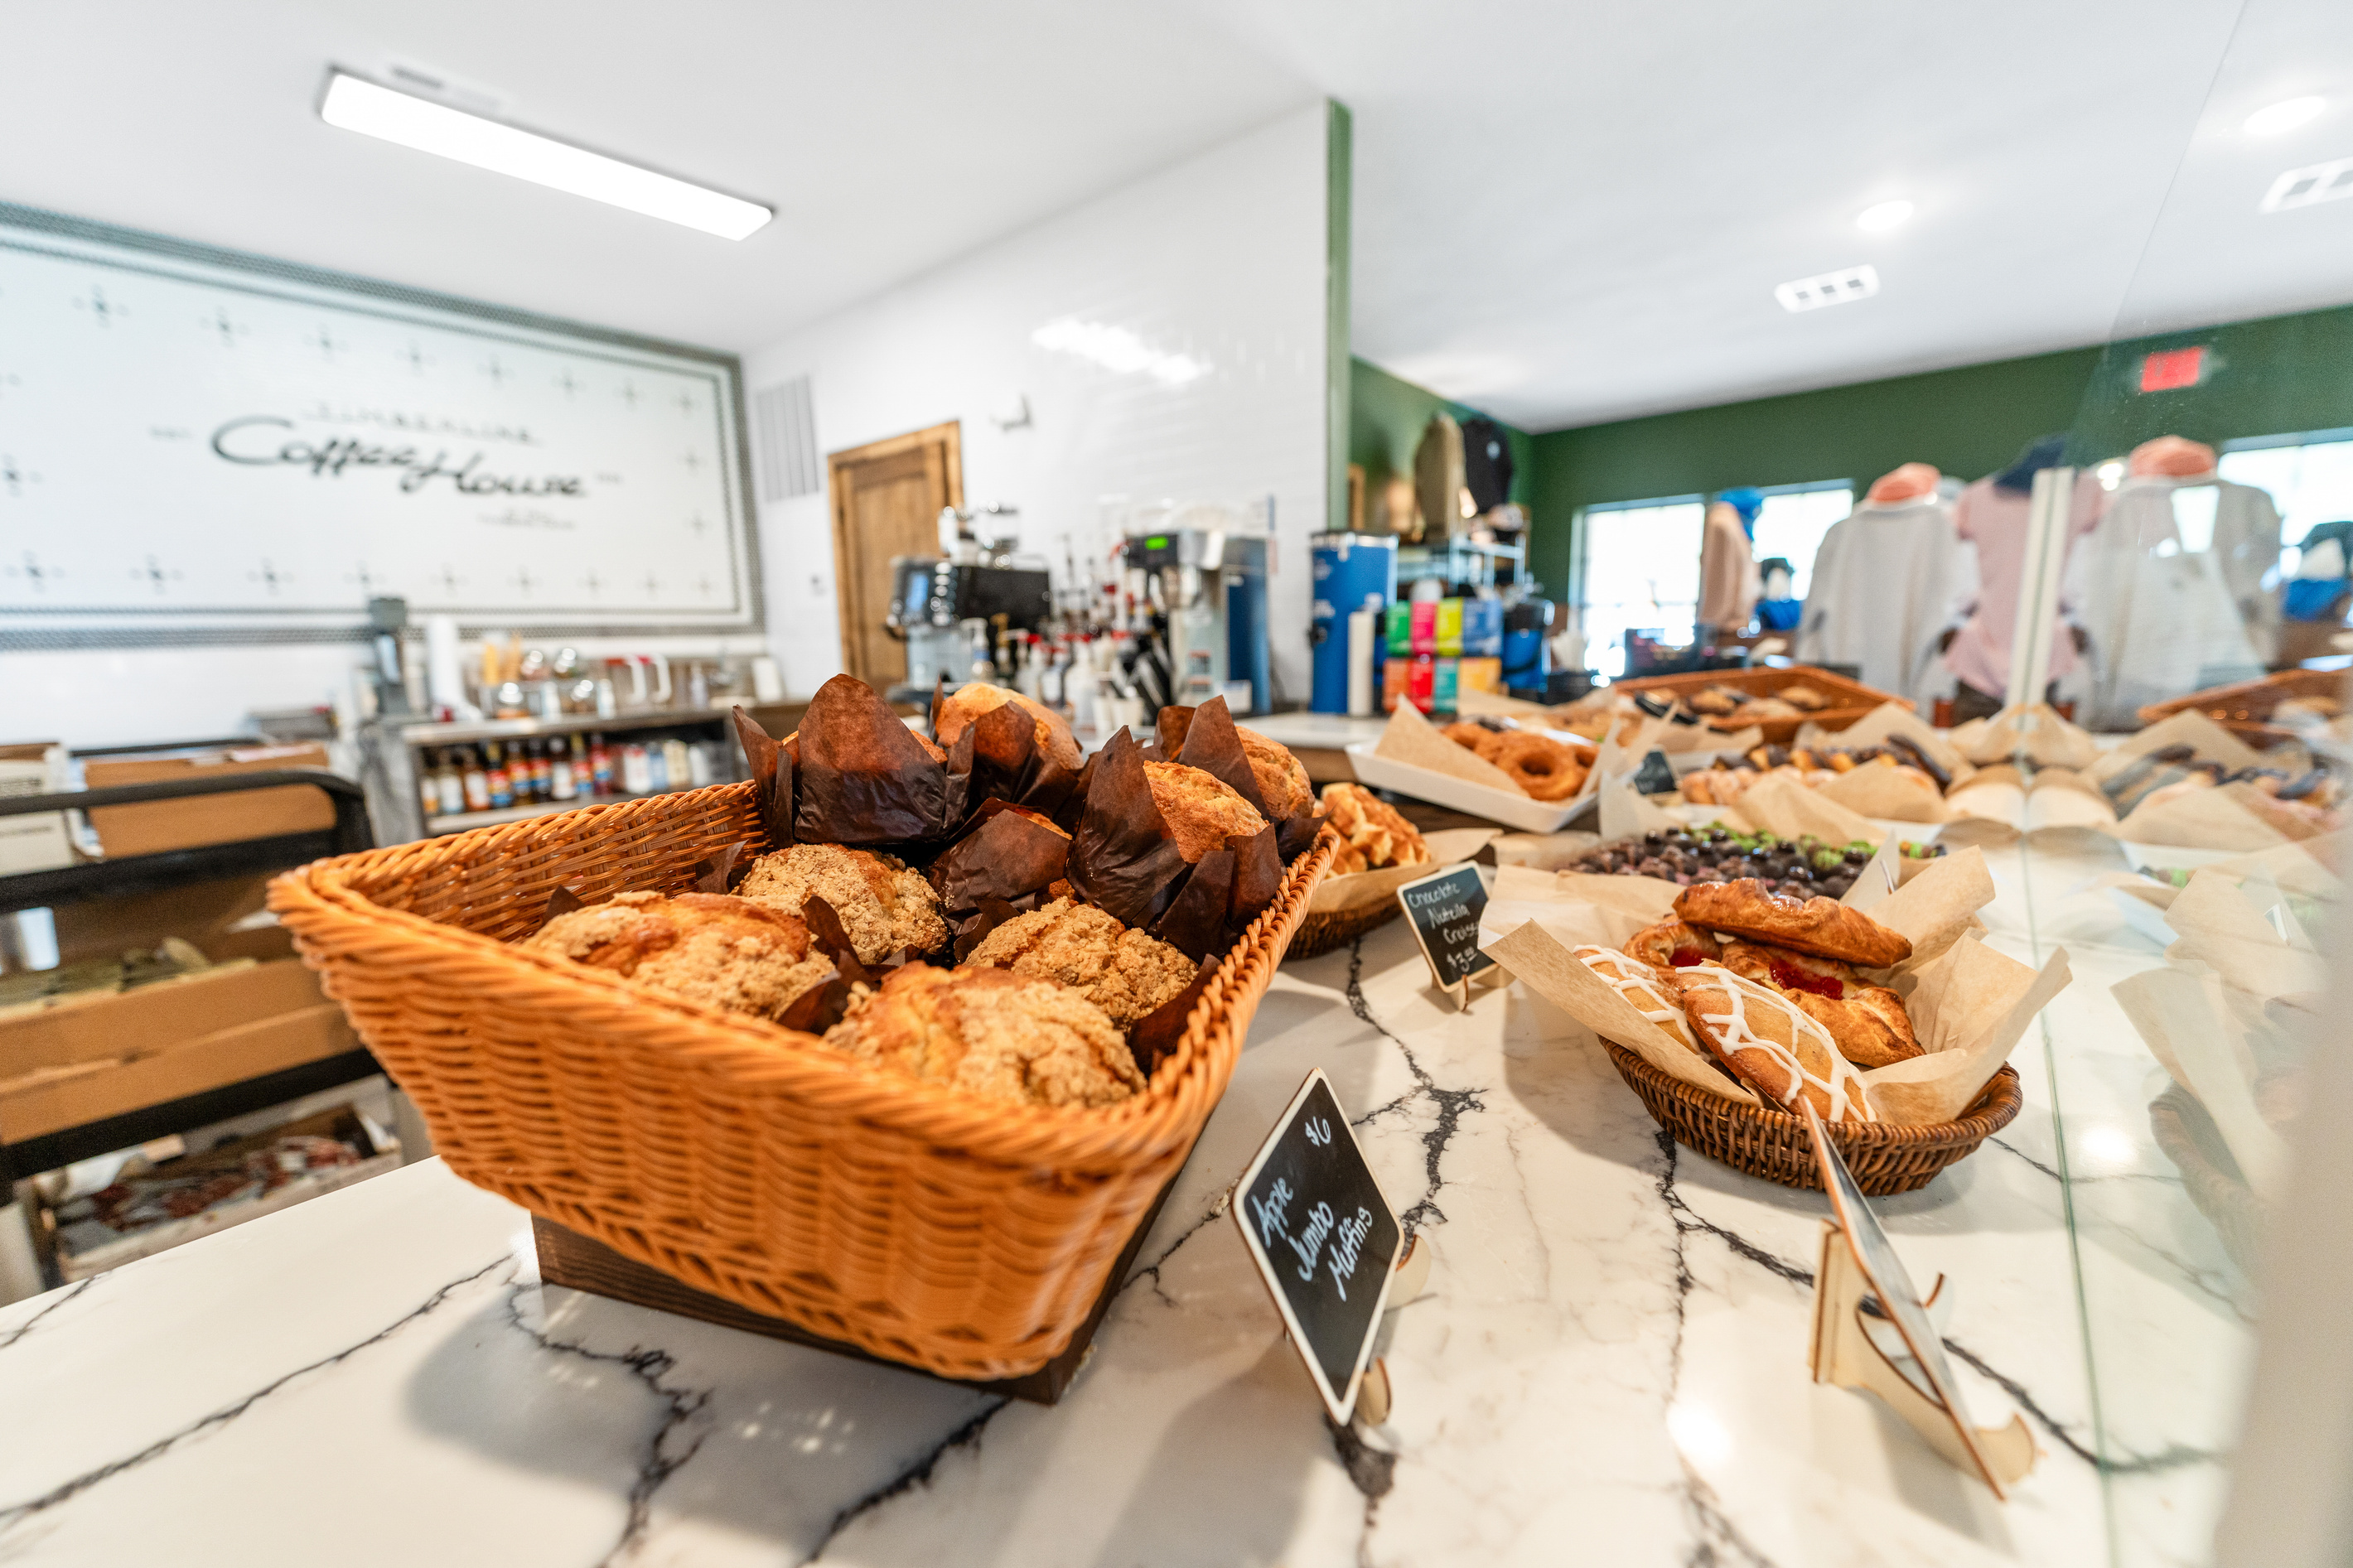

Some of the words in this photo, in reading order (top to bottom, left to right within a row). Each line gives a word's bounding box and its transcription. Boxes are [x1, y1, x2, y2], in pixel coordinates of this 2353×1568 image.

[210, 414, 421, 479] Coffee
[399, 450, 587, 499] House
[1427, 902, 1471, 929] Nutella
[1305, 1116, 1331, 1147] $6
[1251, 1177, 1293, 1249] Apple
[1288, 1201, 1334, 1282] Jumbo
[1327, 1206, 1373, 1302] Muffins
